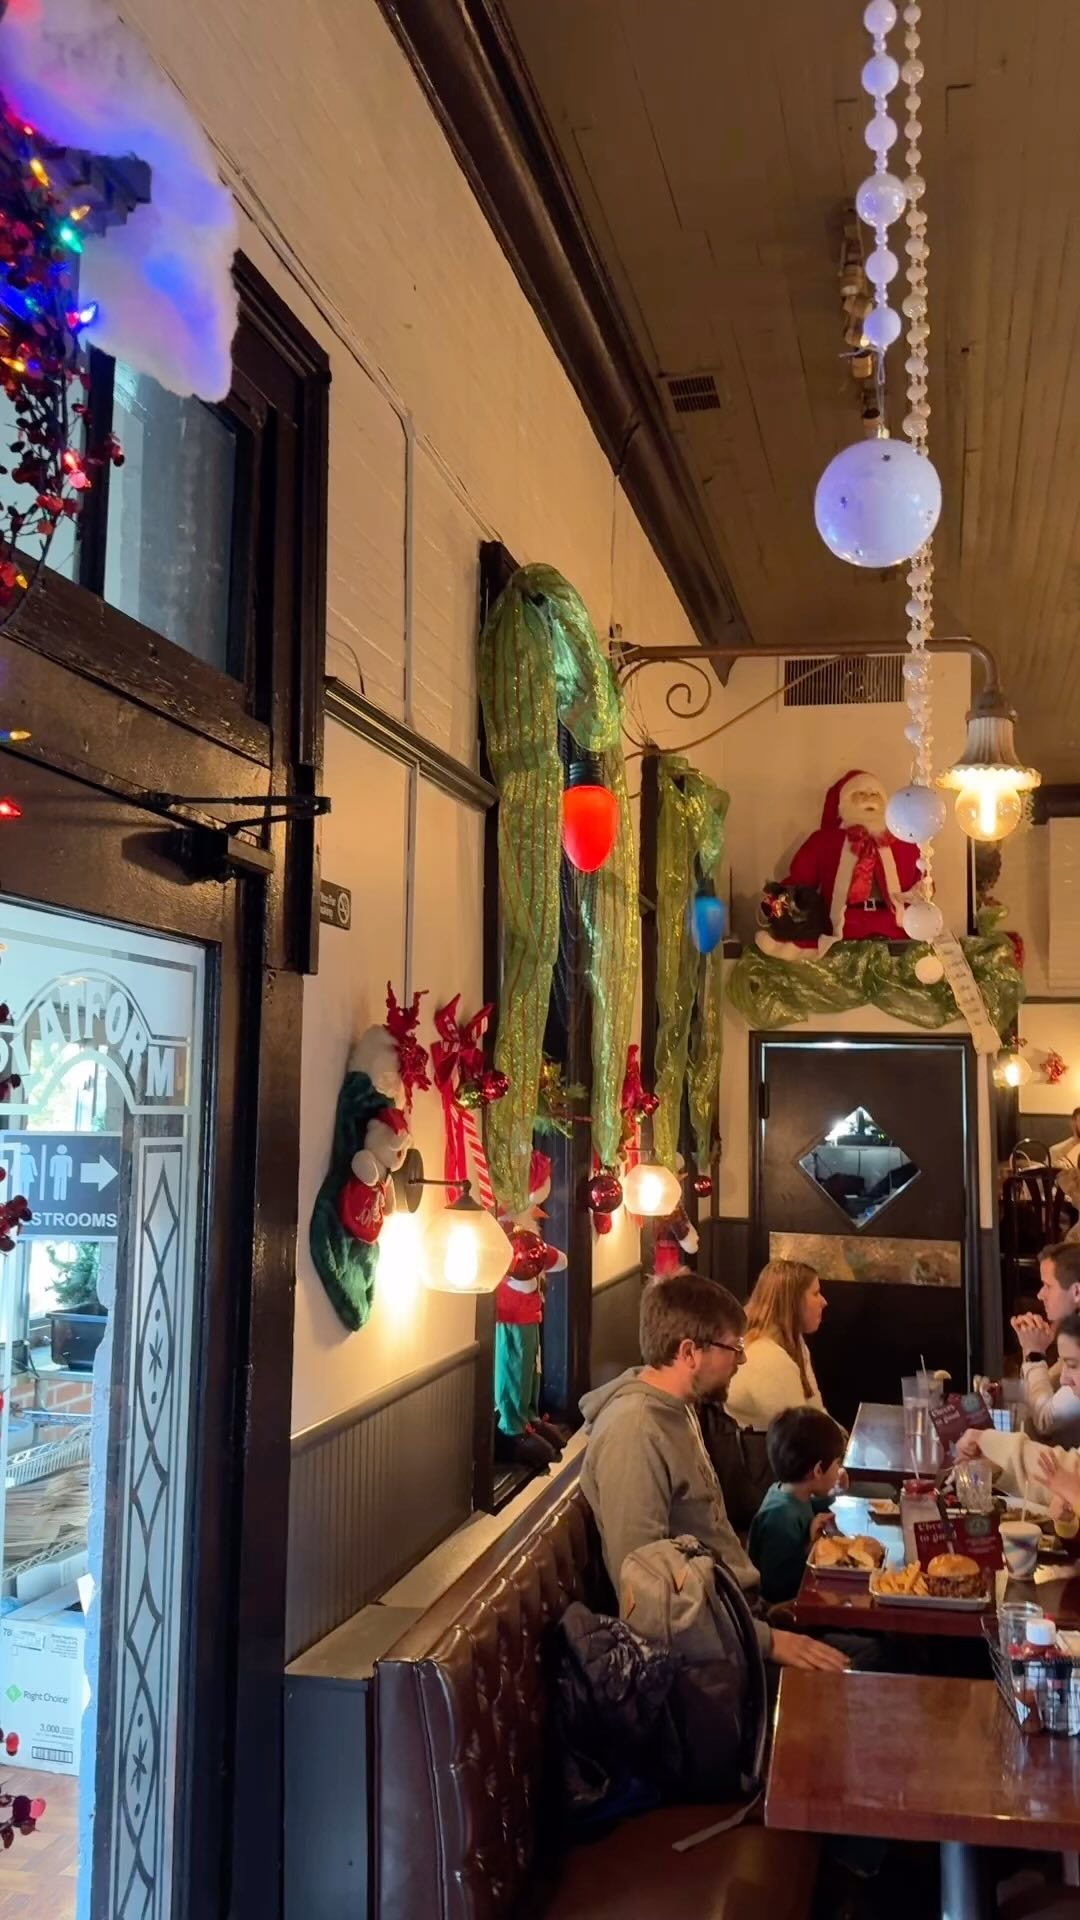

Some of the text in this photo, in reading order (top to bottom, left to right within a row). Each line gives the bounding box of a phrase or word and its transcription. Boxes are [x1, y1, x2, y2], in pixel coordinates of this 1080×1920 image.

[22, 1211, 118, 1228] STROOMS
[23, 1690, 68, 1704] Right Choice
